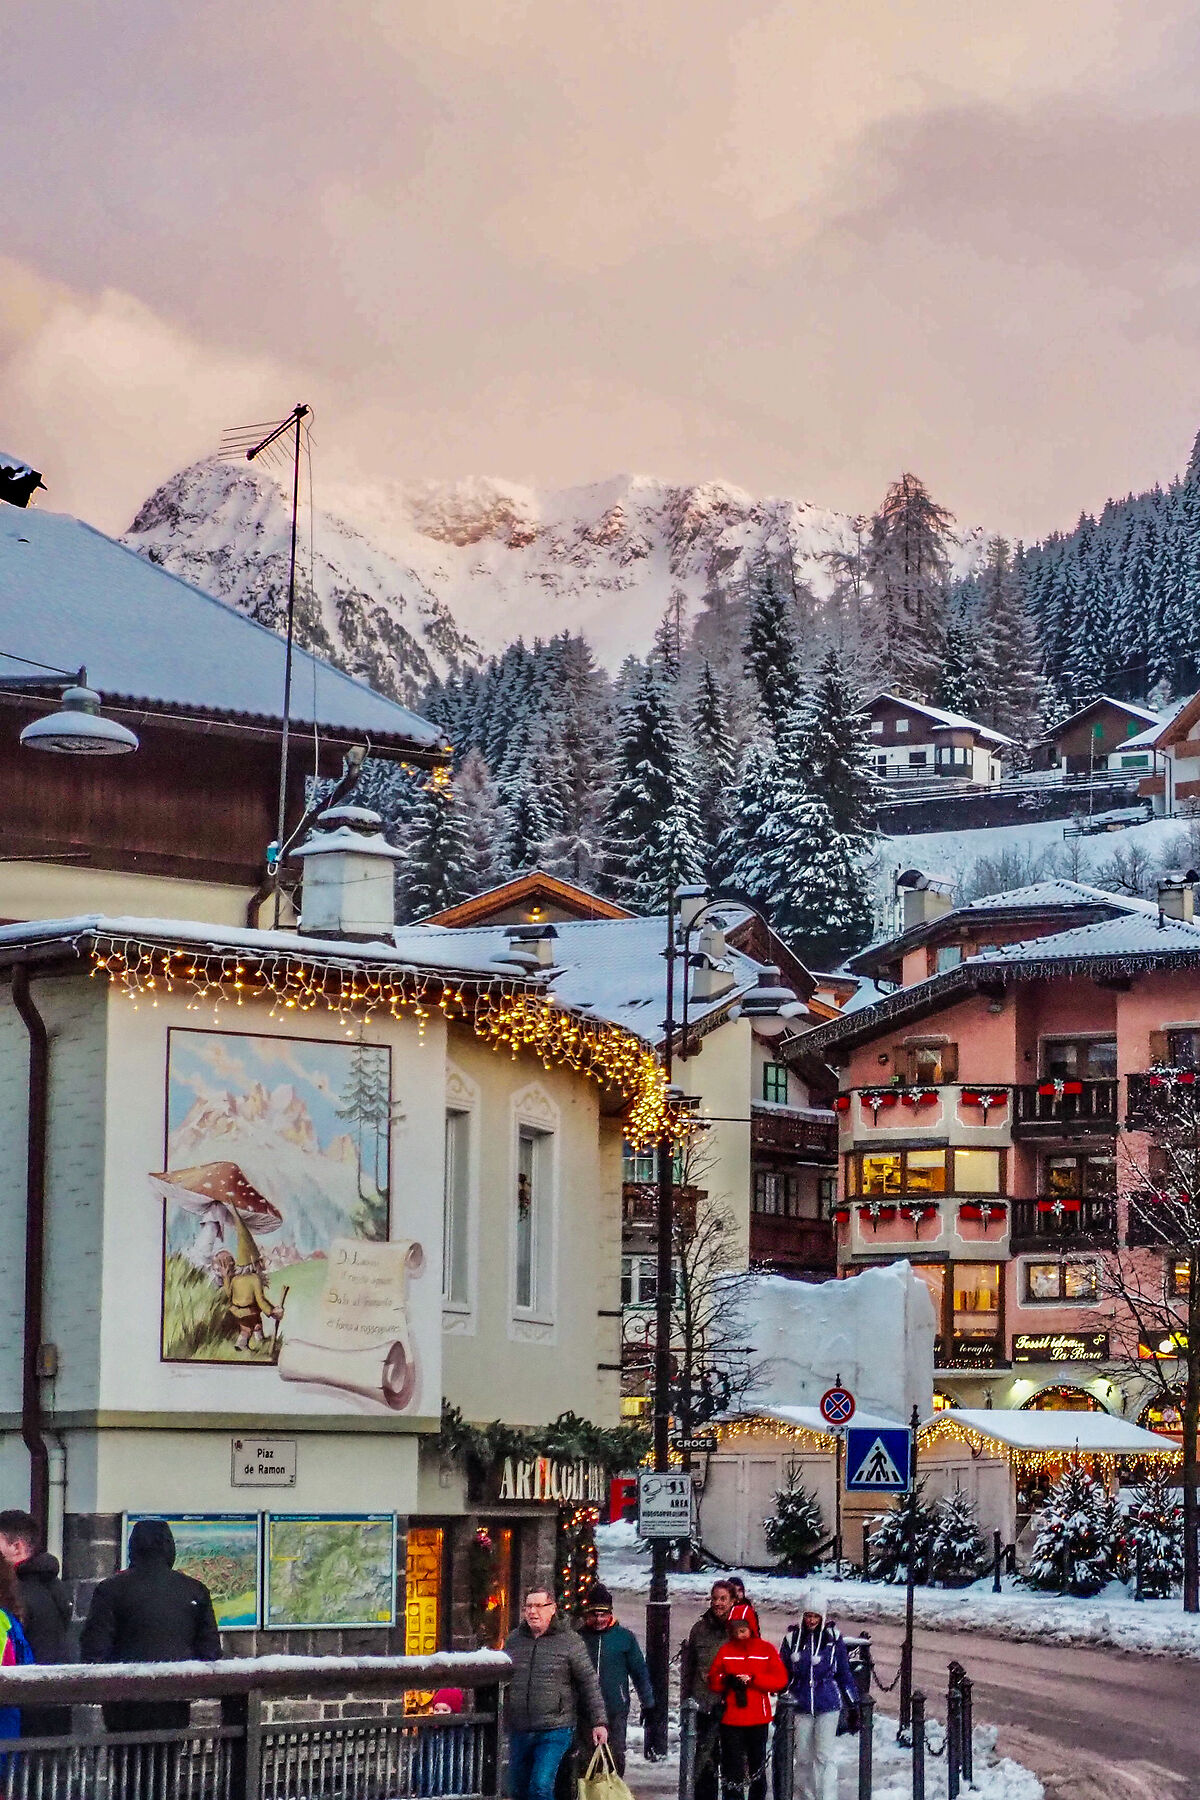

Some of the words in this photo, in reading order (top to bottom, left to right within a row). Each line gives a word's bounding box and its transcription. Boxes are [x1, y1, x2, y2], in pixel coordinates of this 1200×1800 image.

[1015, 1335, 1050, 1349] Tessil
[1050, 1348, 1070, 1361] La
[1069, 1348, 1104, 1361] Bora
[676, 1439, 713, 1448] CROCE
[257, 1448, 274, 1459] Piaz
[244, 1464, 254, 1474] de
[258, 1464, 286, 1474] Ramon
[499, 1456, 584, 1500] ARTICOLI
[670, 1499, 689, 1508] AREA
